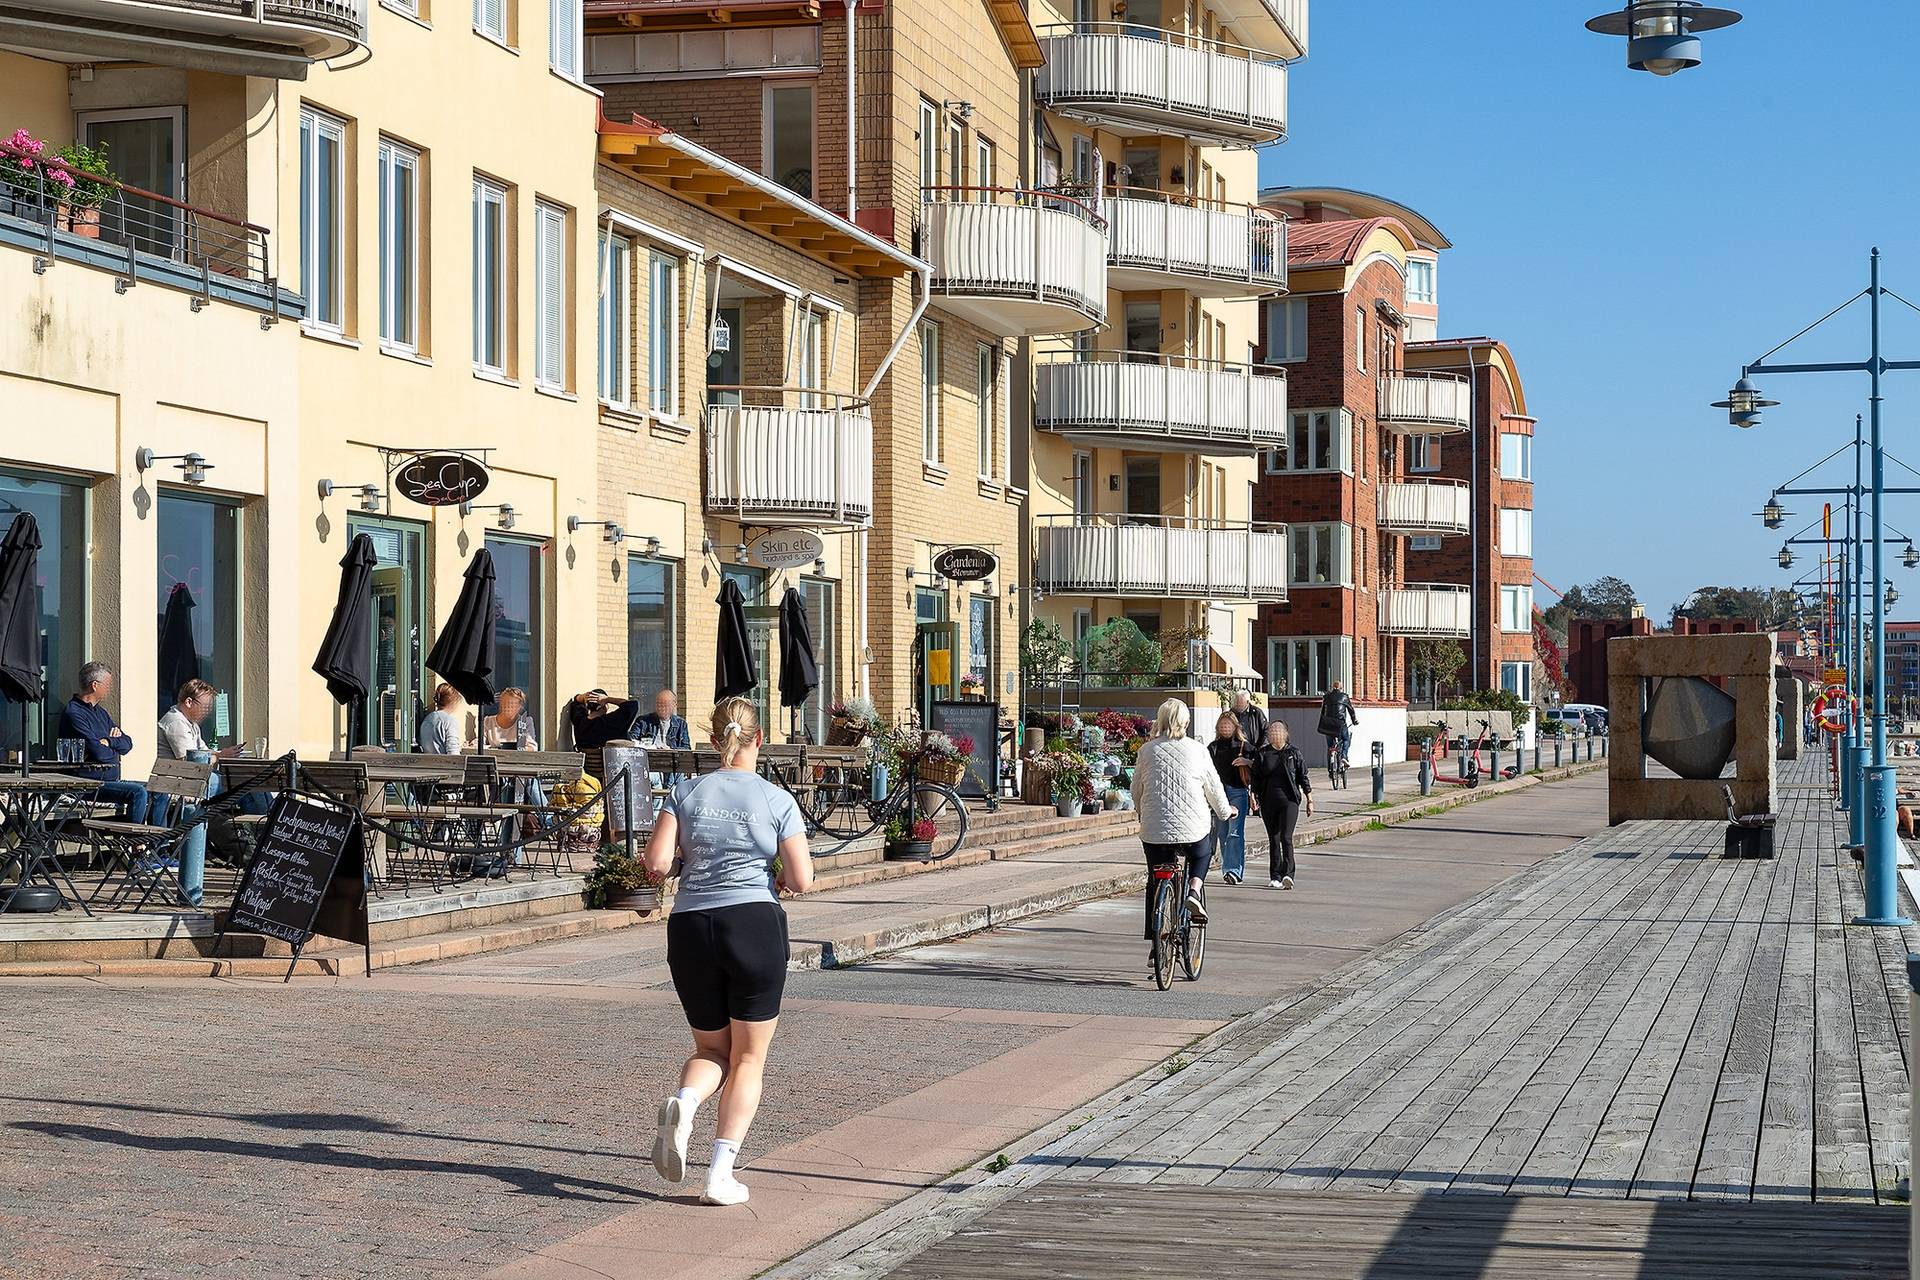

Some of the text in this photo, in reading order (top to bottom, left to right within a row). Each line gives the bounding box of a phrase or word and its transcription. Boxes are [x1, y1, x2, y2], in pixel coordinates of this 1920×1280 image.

[762, 538, 814, 553] Skin etc.
[694, 806, 757, 822] PANDORA
[254, 861, 280, 882] Pasta
